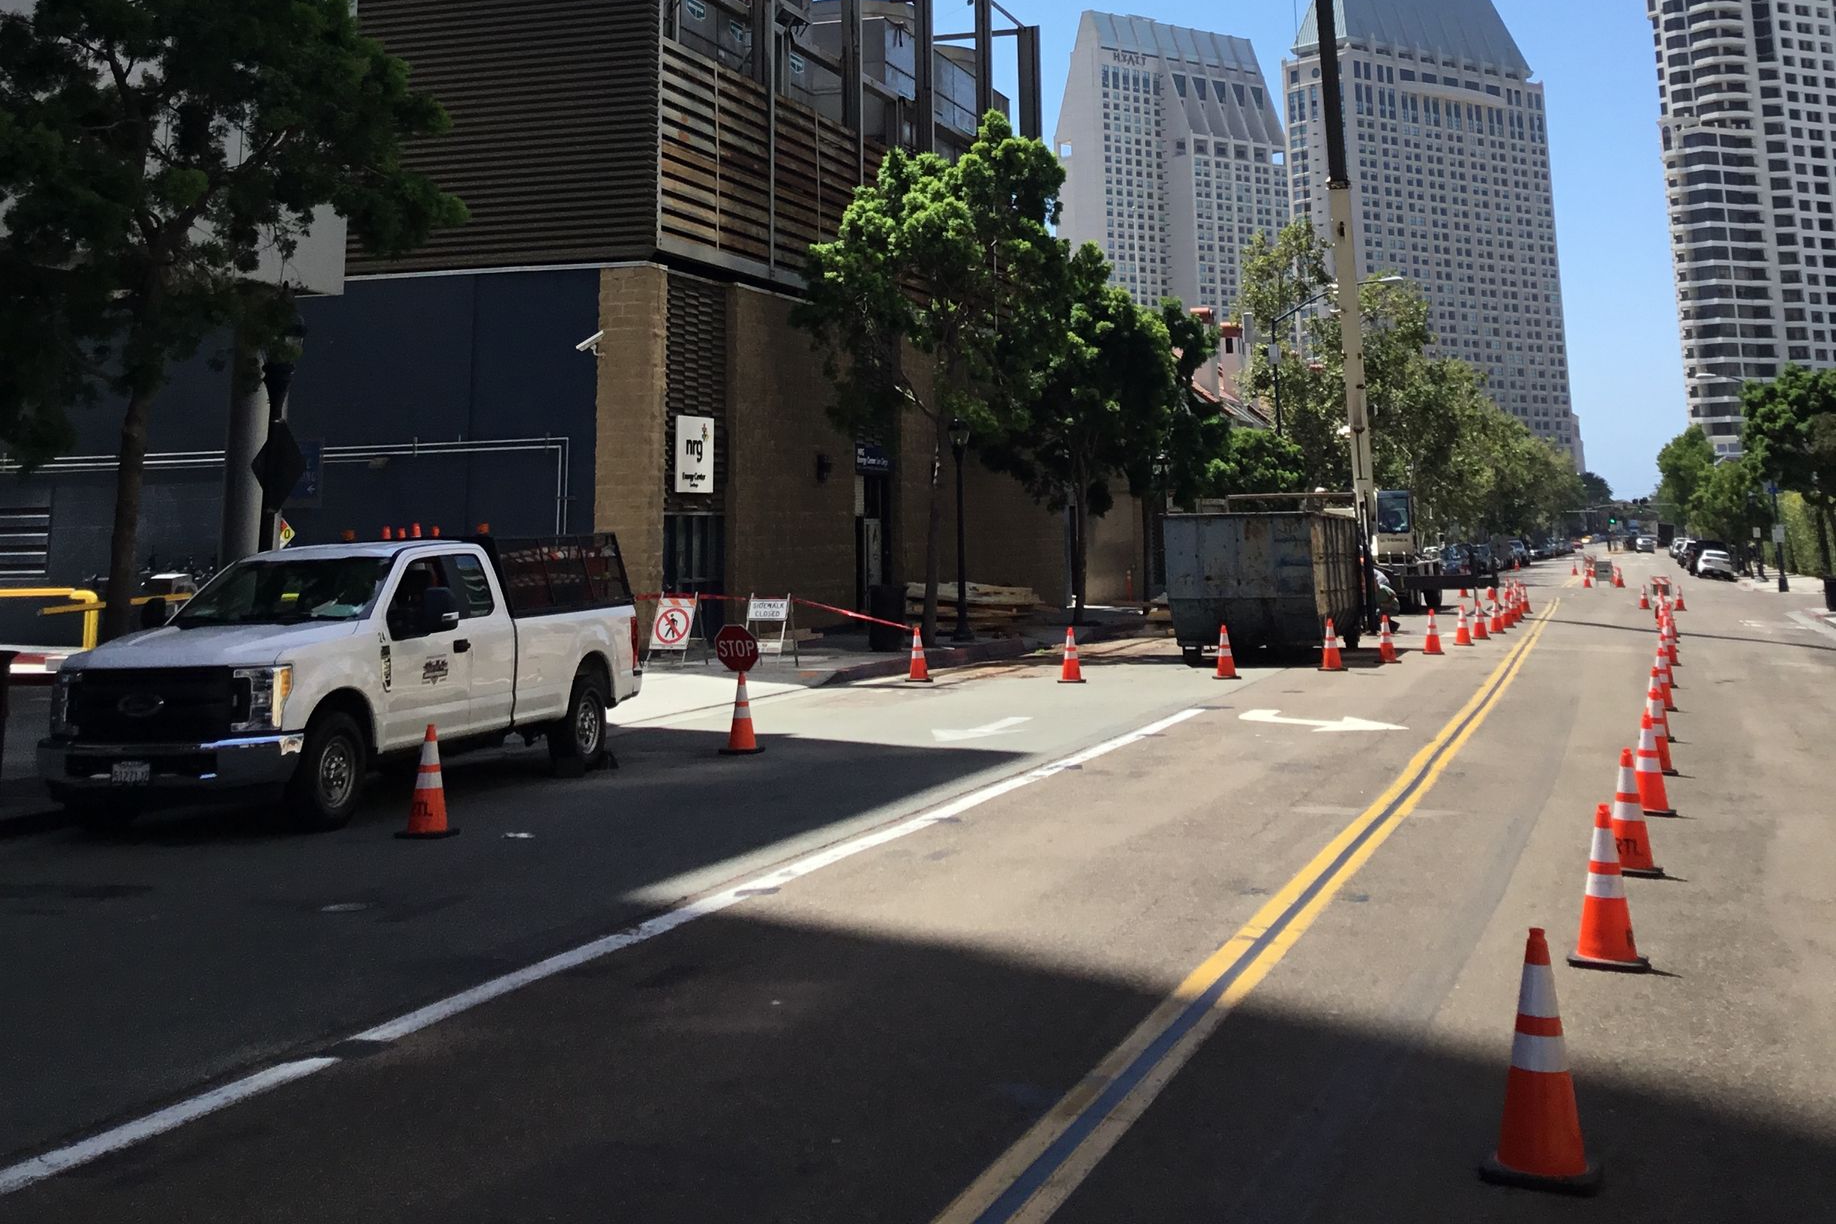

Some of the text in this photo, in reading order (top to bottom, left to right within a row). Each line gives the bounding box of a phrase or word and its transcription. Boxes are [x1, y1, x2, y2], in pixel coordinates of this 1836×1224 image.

[1113, 52, 1146, 66] HYATT
[686, 439, 703, 463] nrg
[718, 640, 754, 657] STOP
